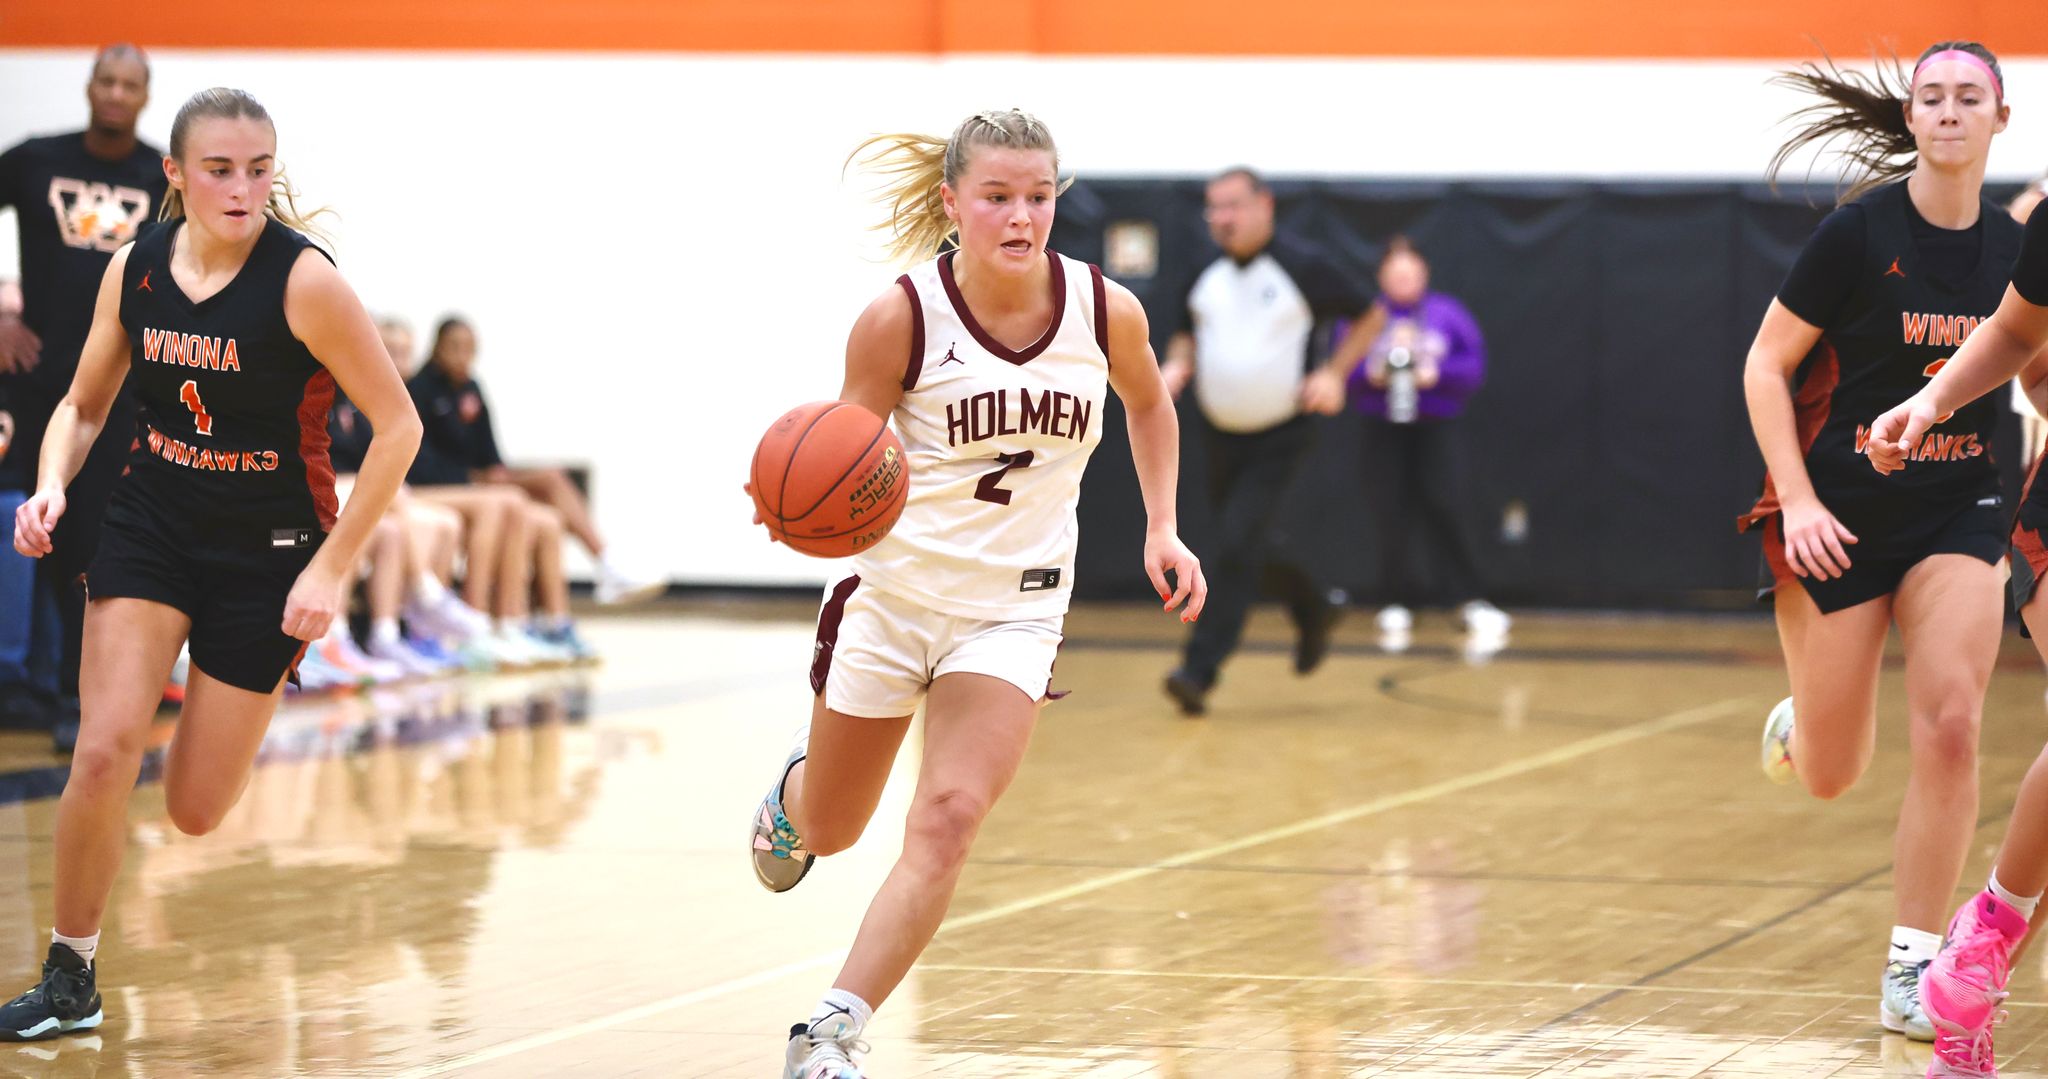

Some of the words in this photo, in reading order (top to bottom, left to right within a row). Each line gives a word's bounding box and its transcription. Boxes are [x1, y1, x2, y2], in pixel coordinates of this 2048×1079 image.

[143, 327, 241, 372] WINONA
[1902, 311, 1987, 347] WINO
[180, 379, 213, 437] 1
[946, 387, 1091, 447] HOLMEN
[973, 450, 1035, 506] 2
[300, 533, 308, 542] M
[1048, 575, 1055, 584] S
